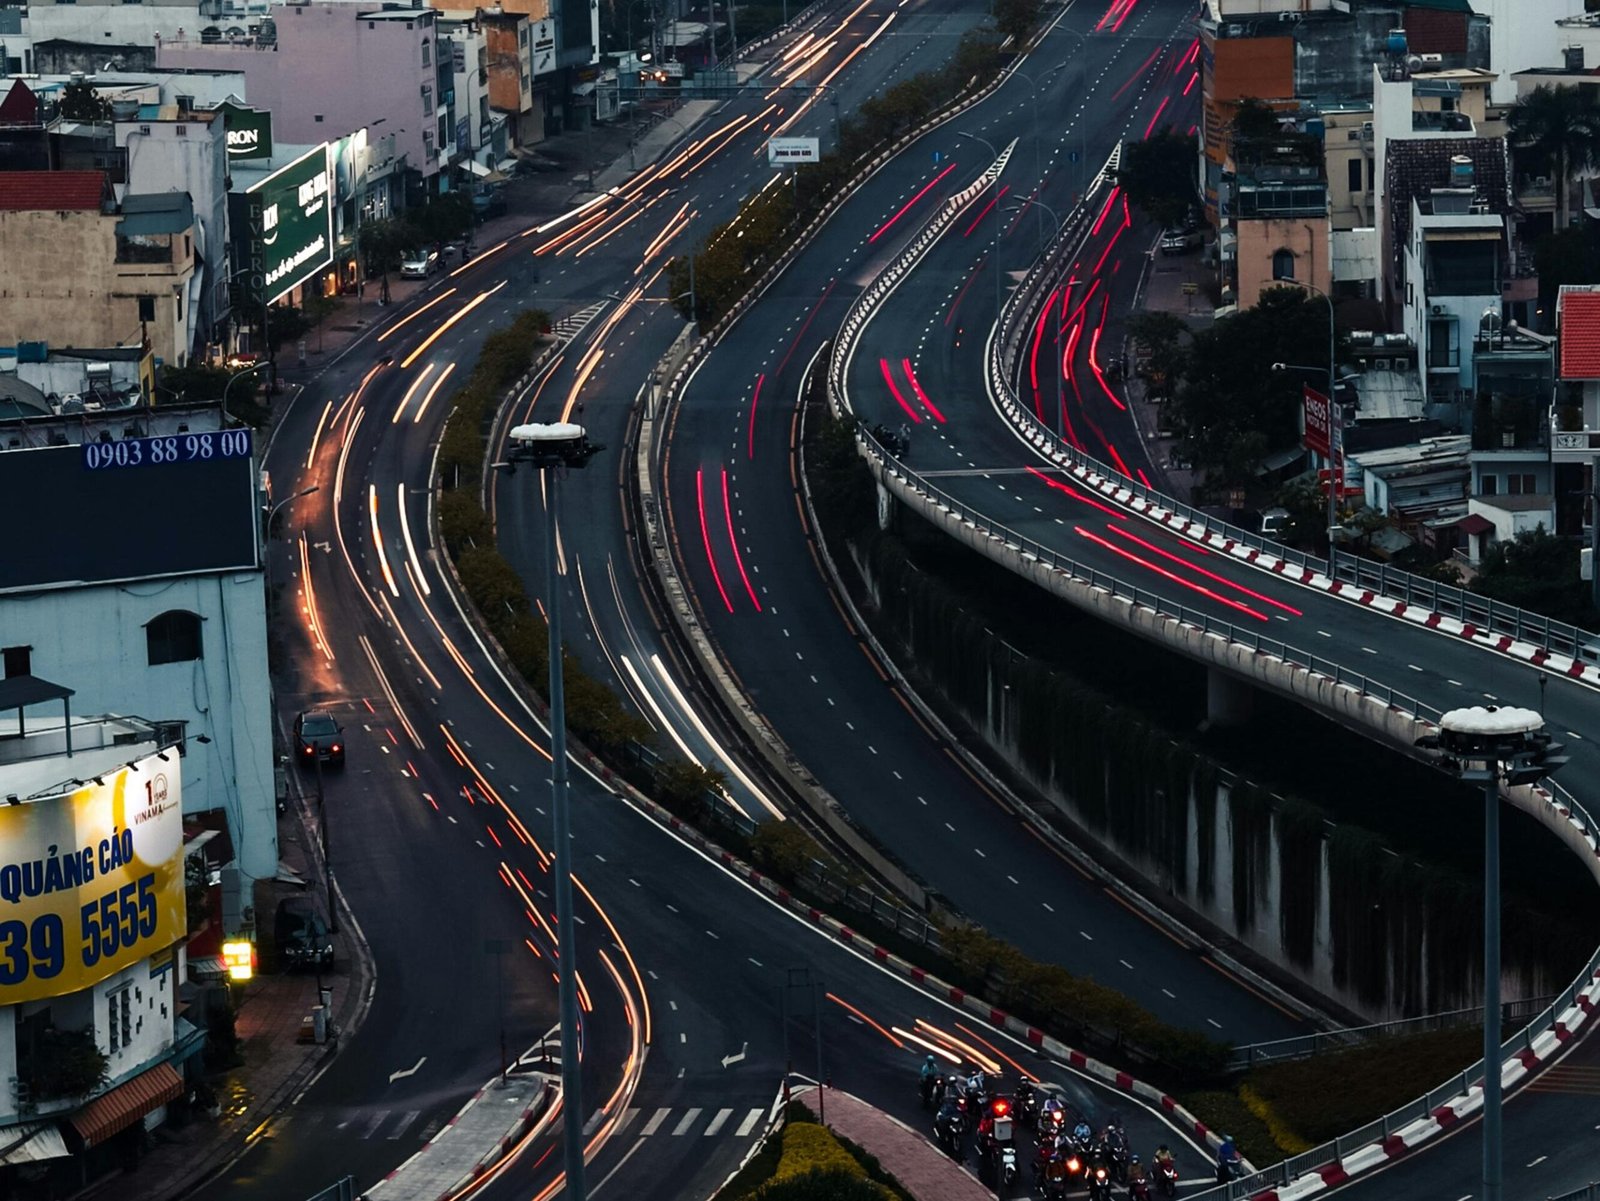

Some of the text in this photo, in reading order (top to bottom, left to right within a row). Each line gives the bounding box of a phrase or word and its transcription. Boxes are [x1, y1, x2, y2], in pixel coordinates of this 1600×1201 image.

[227, 129, 258, 145] RON
[249, 203, 265, 305] EVERON
[1305, 396, 1326, 420] ENEOS
[86, 431, 248, 469] 0903 88 98 00
[0, 826, 134, 903] QUẢNG CÁO
[81, 873, 157, 967] 5555
